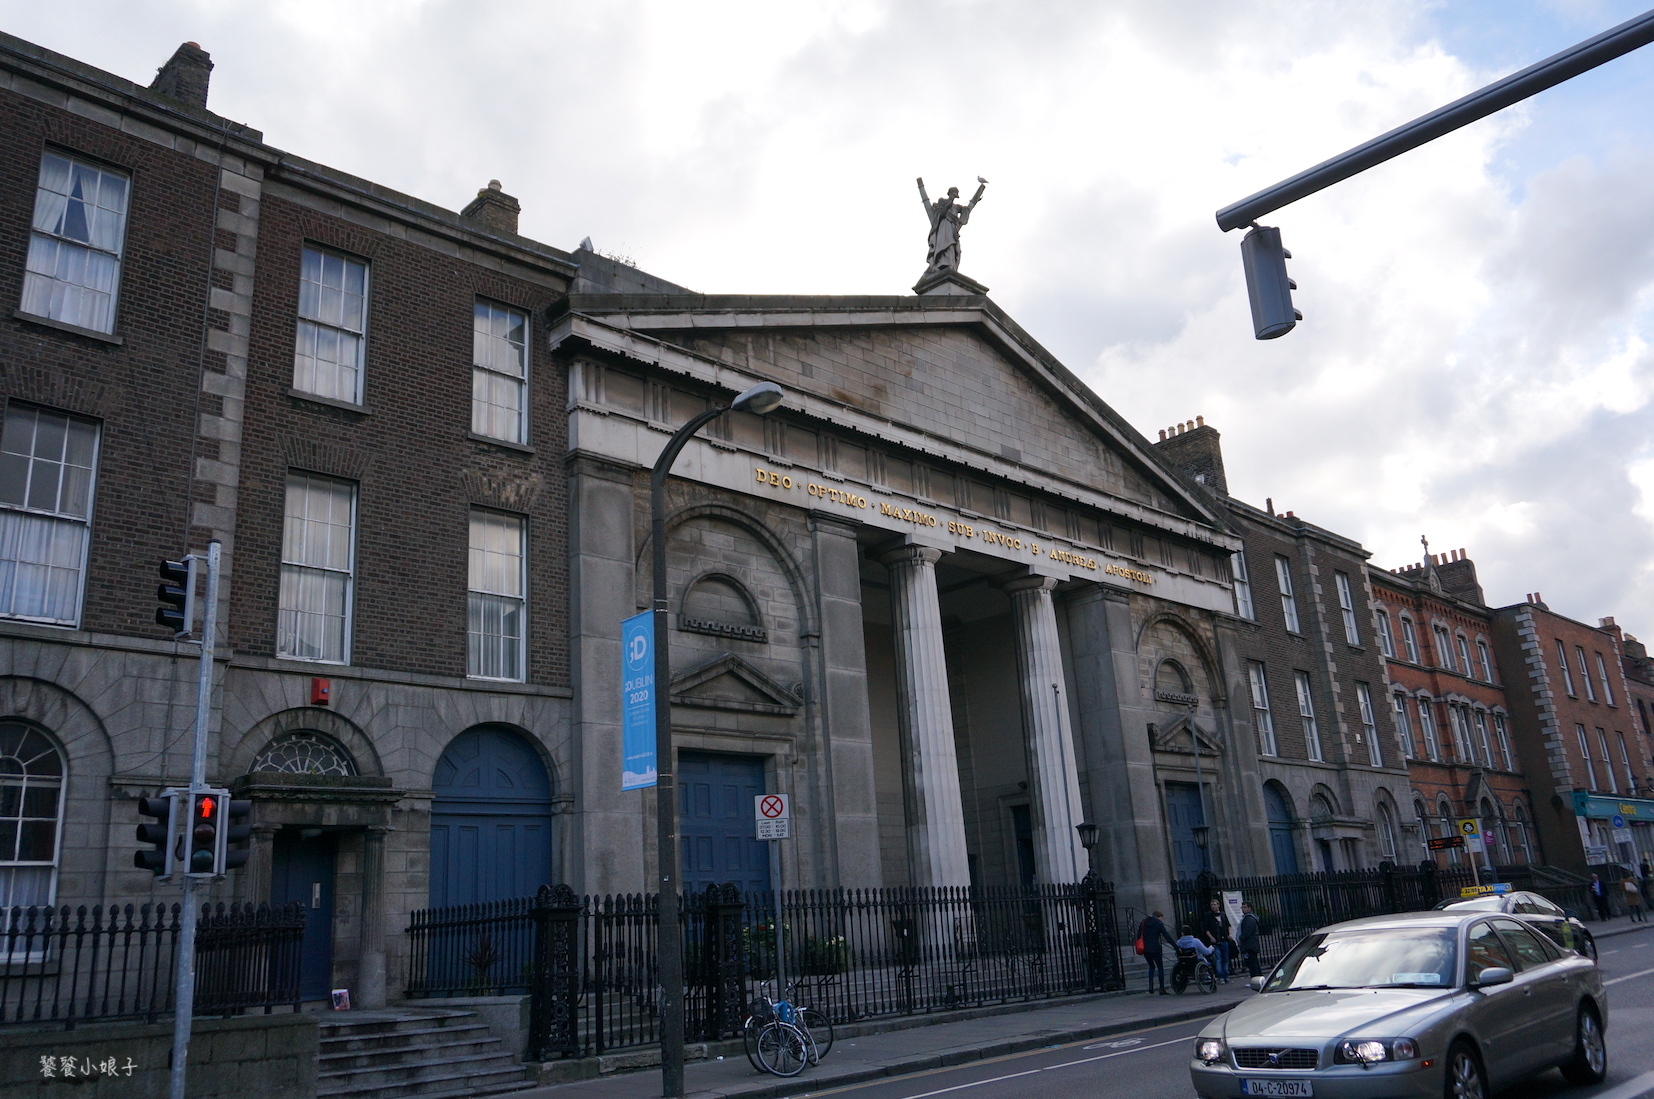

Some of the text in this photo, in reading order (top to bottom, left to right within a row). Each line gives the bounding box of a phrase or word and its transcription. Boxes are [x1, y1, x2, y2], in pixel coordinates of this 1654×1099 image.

[755, 467, 792, 489] DEO
[807, 482, 867, 509] OPTIMO
[880, 502, 937, 528] MAXIMO
[947, 520, 974, 538] SUB
[982, 529, 1021, 550] INVOC
[1030, 542, 1040, 555] B
[1105, 563, 1153, 585] APOSTOLI
[629, 689, 649, 704] 2020
[1619, 803, 1637, 816] Centra
[1478, 885, 1494, 893] TAXI
[1252, 1081, 1308, 1095] 04-C-20974
